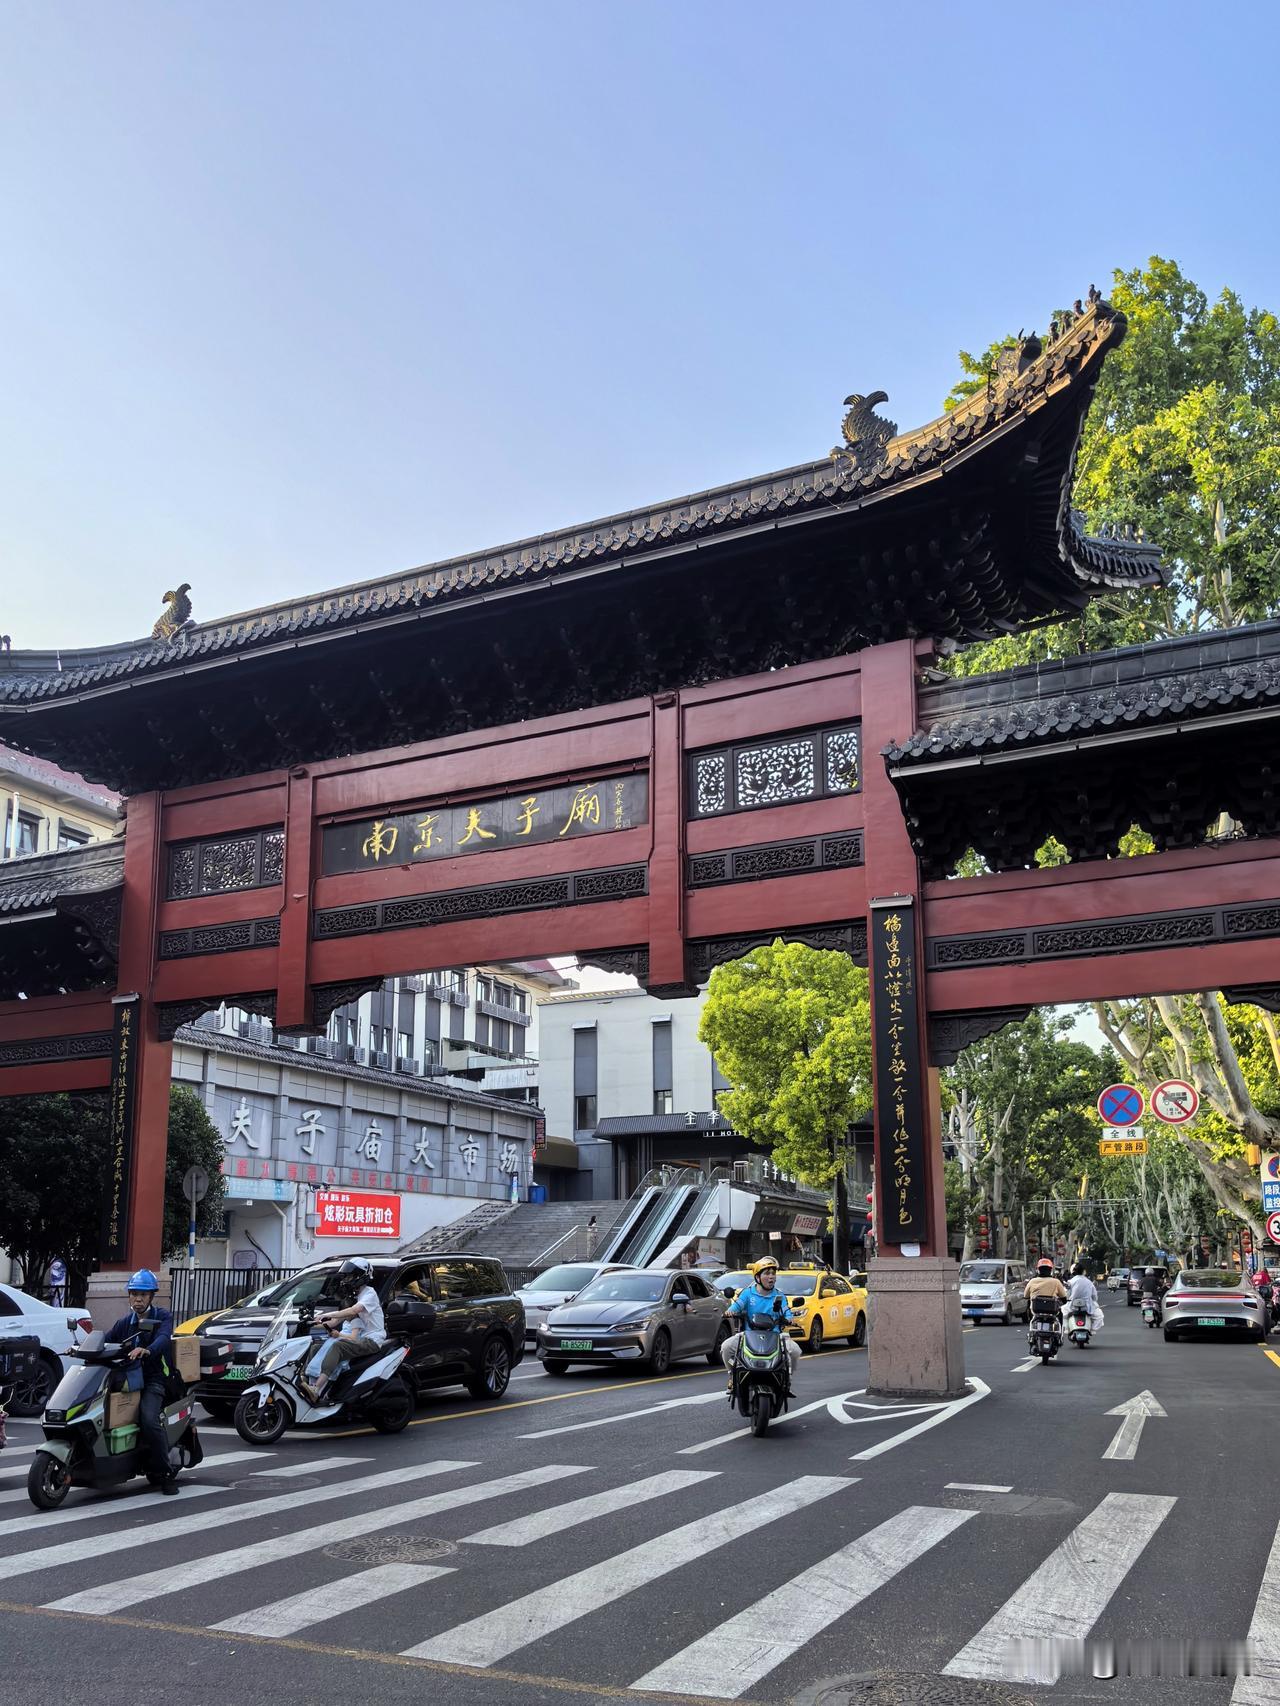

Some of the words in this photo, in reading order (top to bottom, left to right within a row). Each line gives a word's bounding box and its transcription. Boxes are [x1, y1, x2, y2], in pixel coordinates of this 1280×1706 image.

[225, 1096, 520, 1175] 夫子庙大市场
[1110, 1128, 1137, 1139] 全线
[1103, 1142, 1145, 1152] 严管路段
[1265, 1184, 1280, 1195] 路段
[324, 1204, 393, 1224] 炫彩玩具折扣仓
